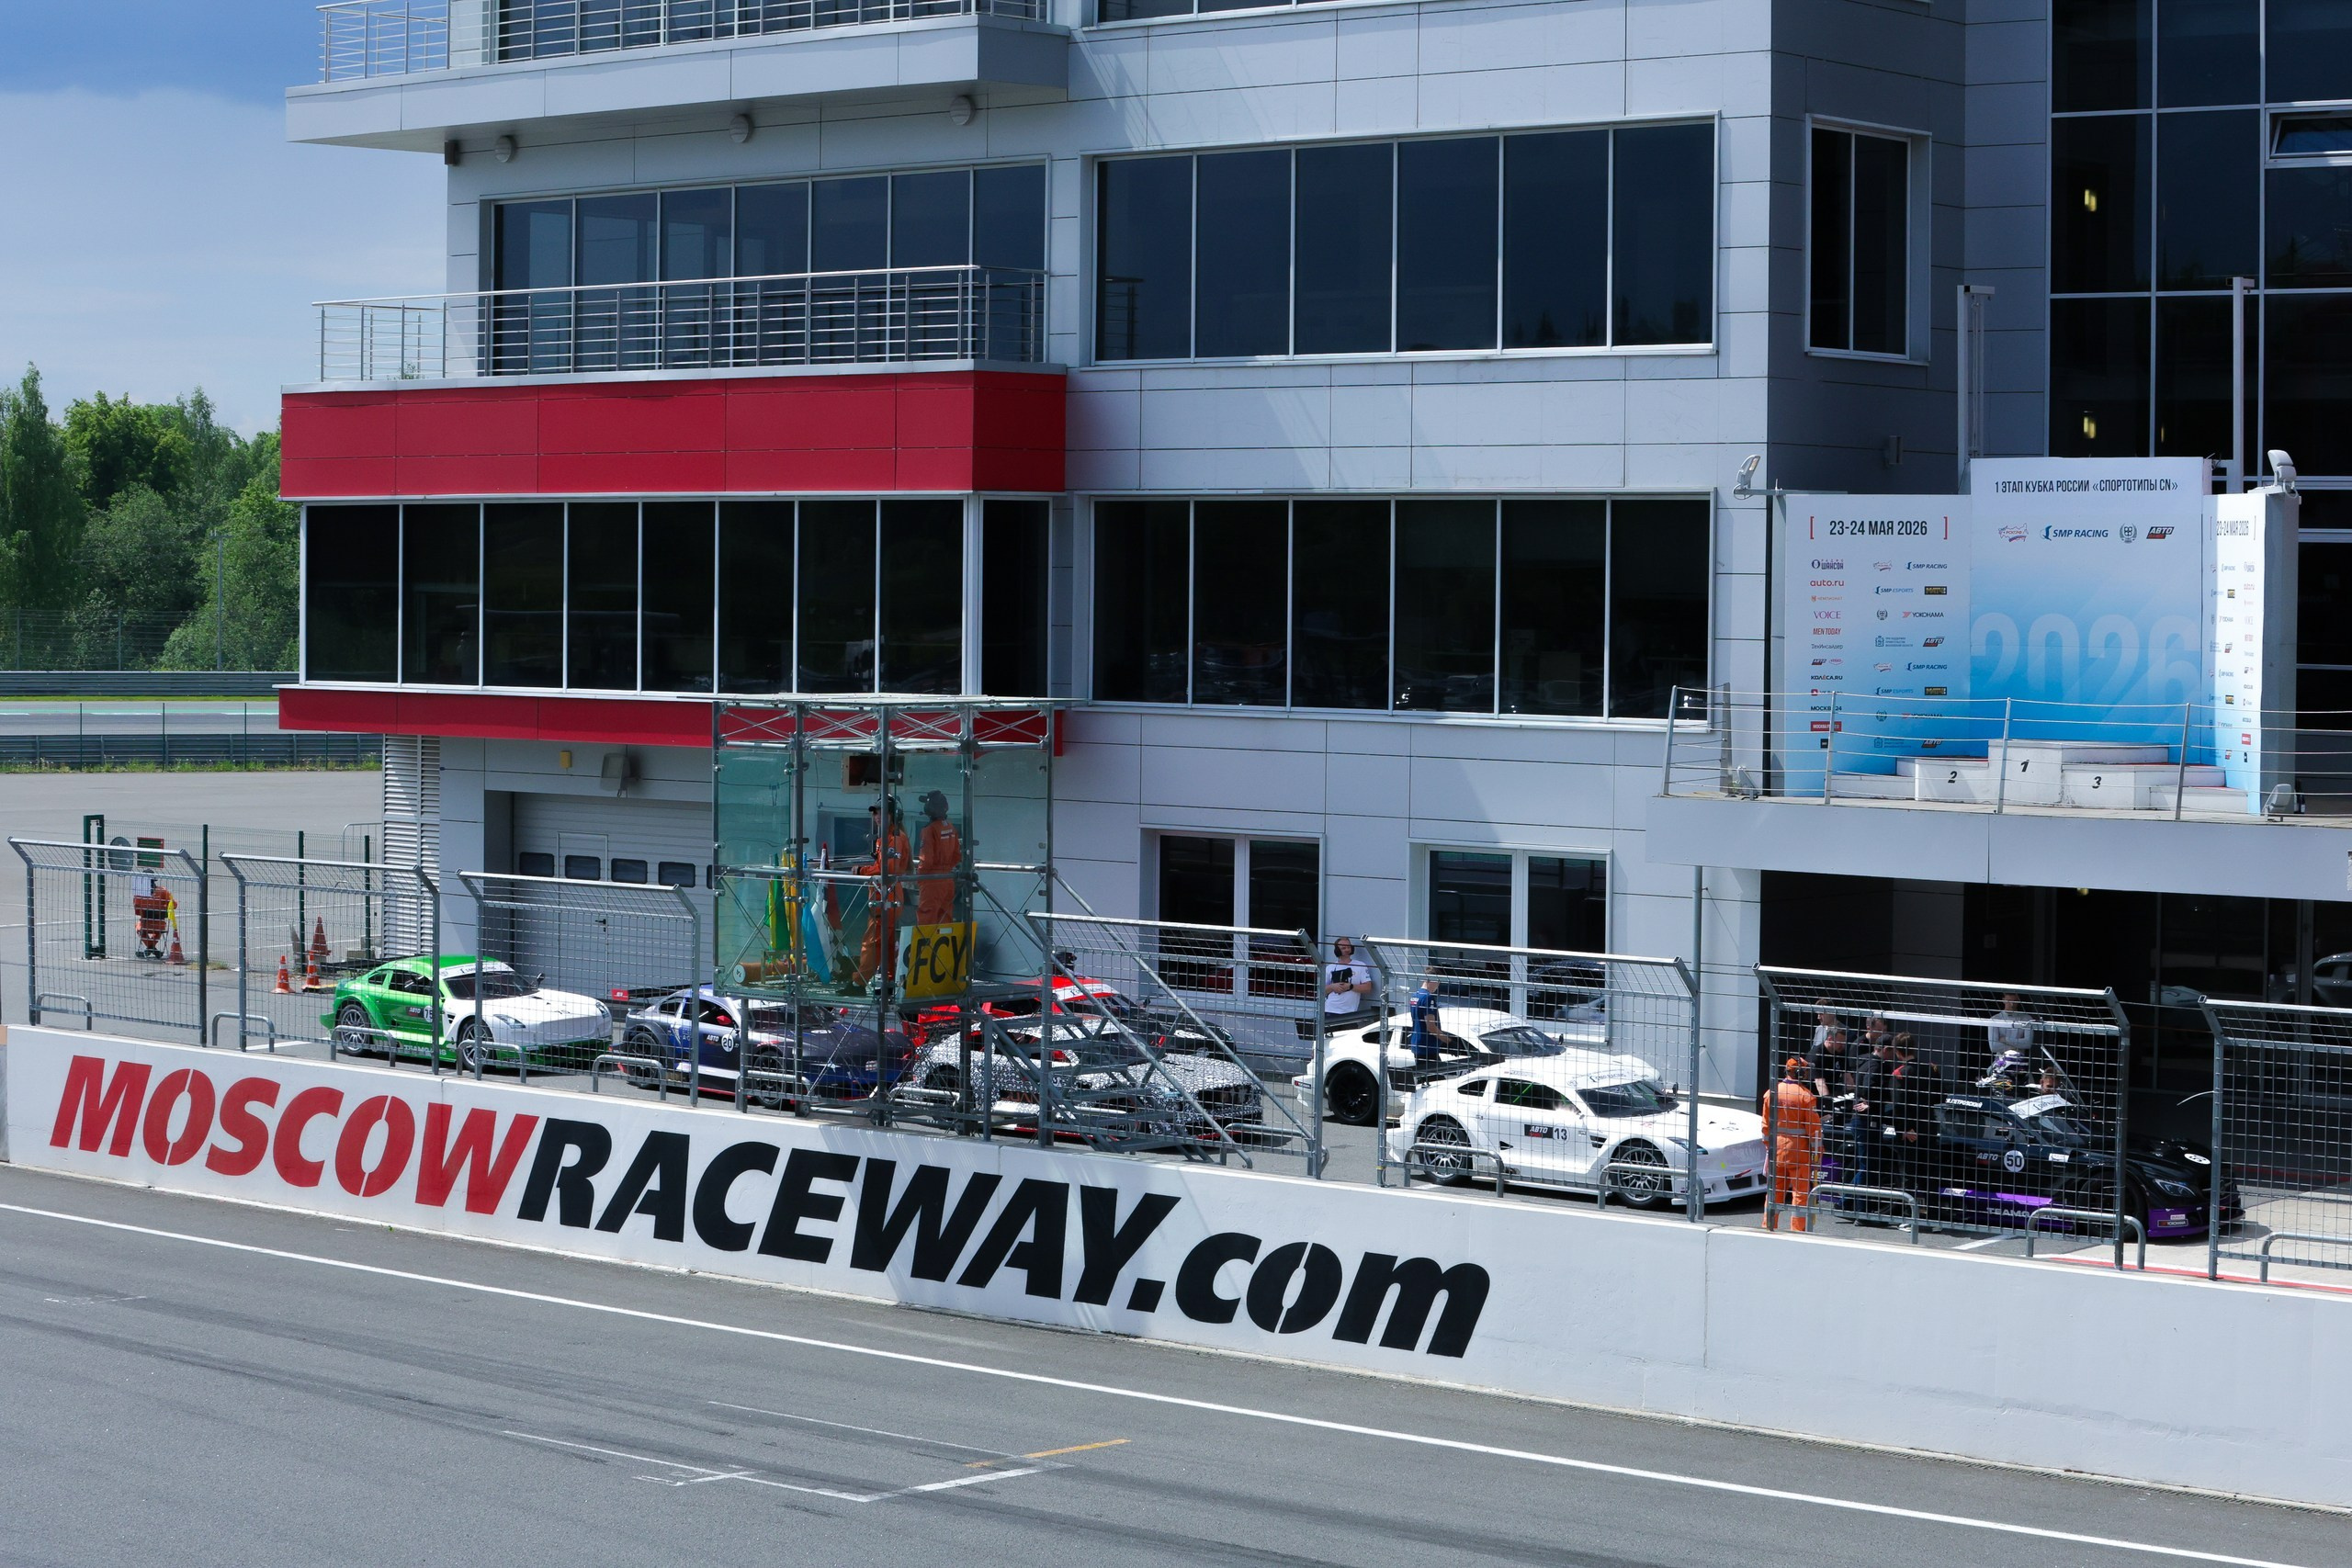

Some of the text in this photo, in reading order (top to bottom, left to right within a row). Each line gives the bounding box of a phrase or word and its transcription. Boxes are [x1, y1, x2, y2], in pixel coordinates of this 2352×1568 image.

[1995, 481, 1999, 493] 1
[2001, 480, 2023, 493] ЭТАП
[2025, 480, 2053, 493] КУБКА
[2056, 479, 2090, 492] РОССИИ
[2092, 479, 2157, 492] «СПОРТОТИПЫ
[1829, 520, 1928, 536] 23-24 МАЯ 2026
[2052, 528, 2109, 538] SMP RACING
[1809, 579, 1845, 587] auto.ru
[1814, 610, 1841, 620] VOICE
[1813, 627, 1842, 636] MEN TODAY
[1971, 613, 2201, 716] 2026
[2020, 760, 2030, 773] 1
[1948, 771, 1958, 784] 2
[2092, 776, 2102, 789] 3
[912, 935, 967, 986] FCY
[722, 1037, 732, 1049] 20
[1554, 1127, 1567, 1140] 13
[1976, 1152, 2022, 1168] АВТО 50
[51, 1055, 1490, 1358] MOSCOWRACEWAY.com
